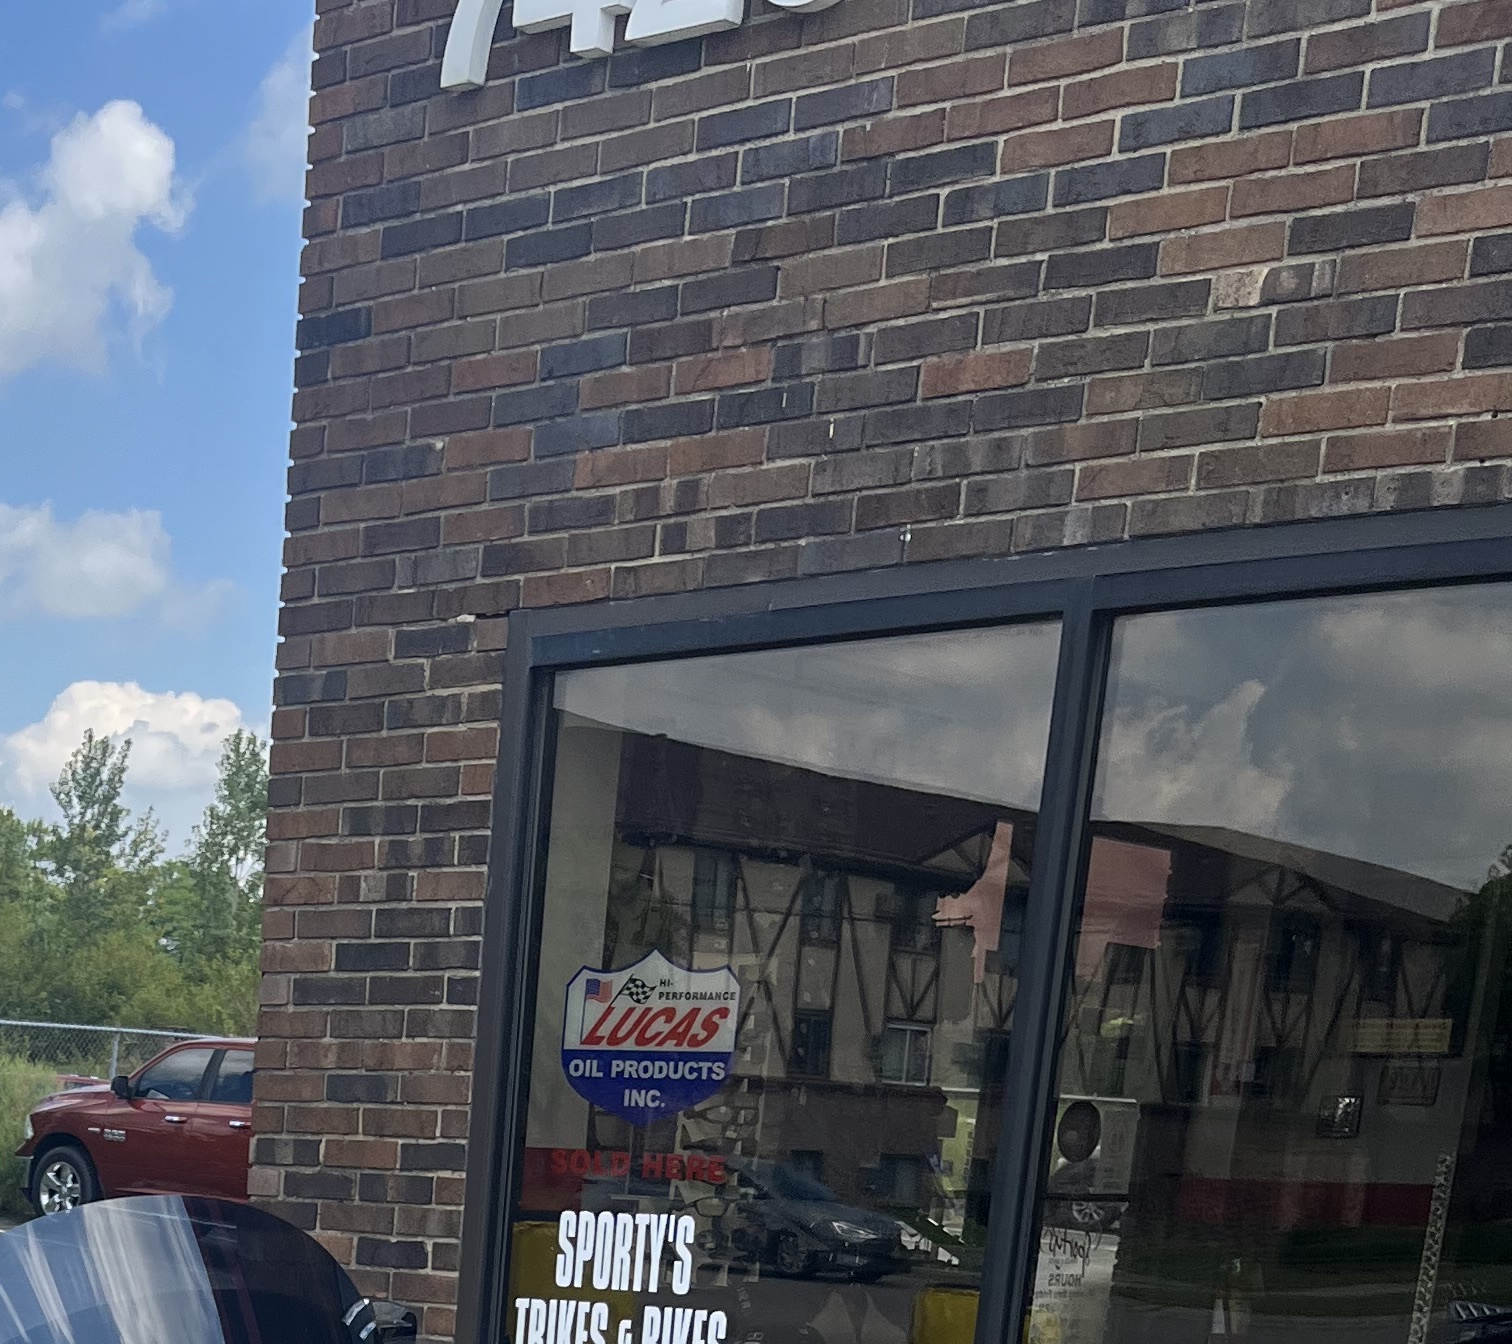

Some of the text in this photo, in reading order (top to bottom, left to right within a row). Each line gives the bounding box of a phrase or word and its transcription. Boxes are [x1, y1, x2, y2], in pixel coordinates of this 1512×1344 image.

[659, 978, 674, 987] HI-
[658, 991, 736, 1001] PERFORMANCE
[580, 1006, 731, 1047] LUCAS
[568, 1059, 726, 1081] OIL PRODUCTS
[623, 1088, 666, 1108] INC.
[550, 1149, 728, 1184] SOLD HERE
[555, 1210, 695, 1296] SPORTY'S
